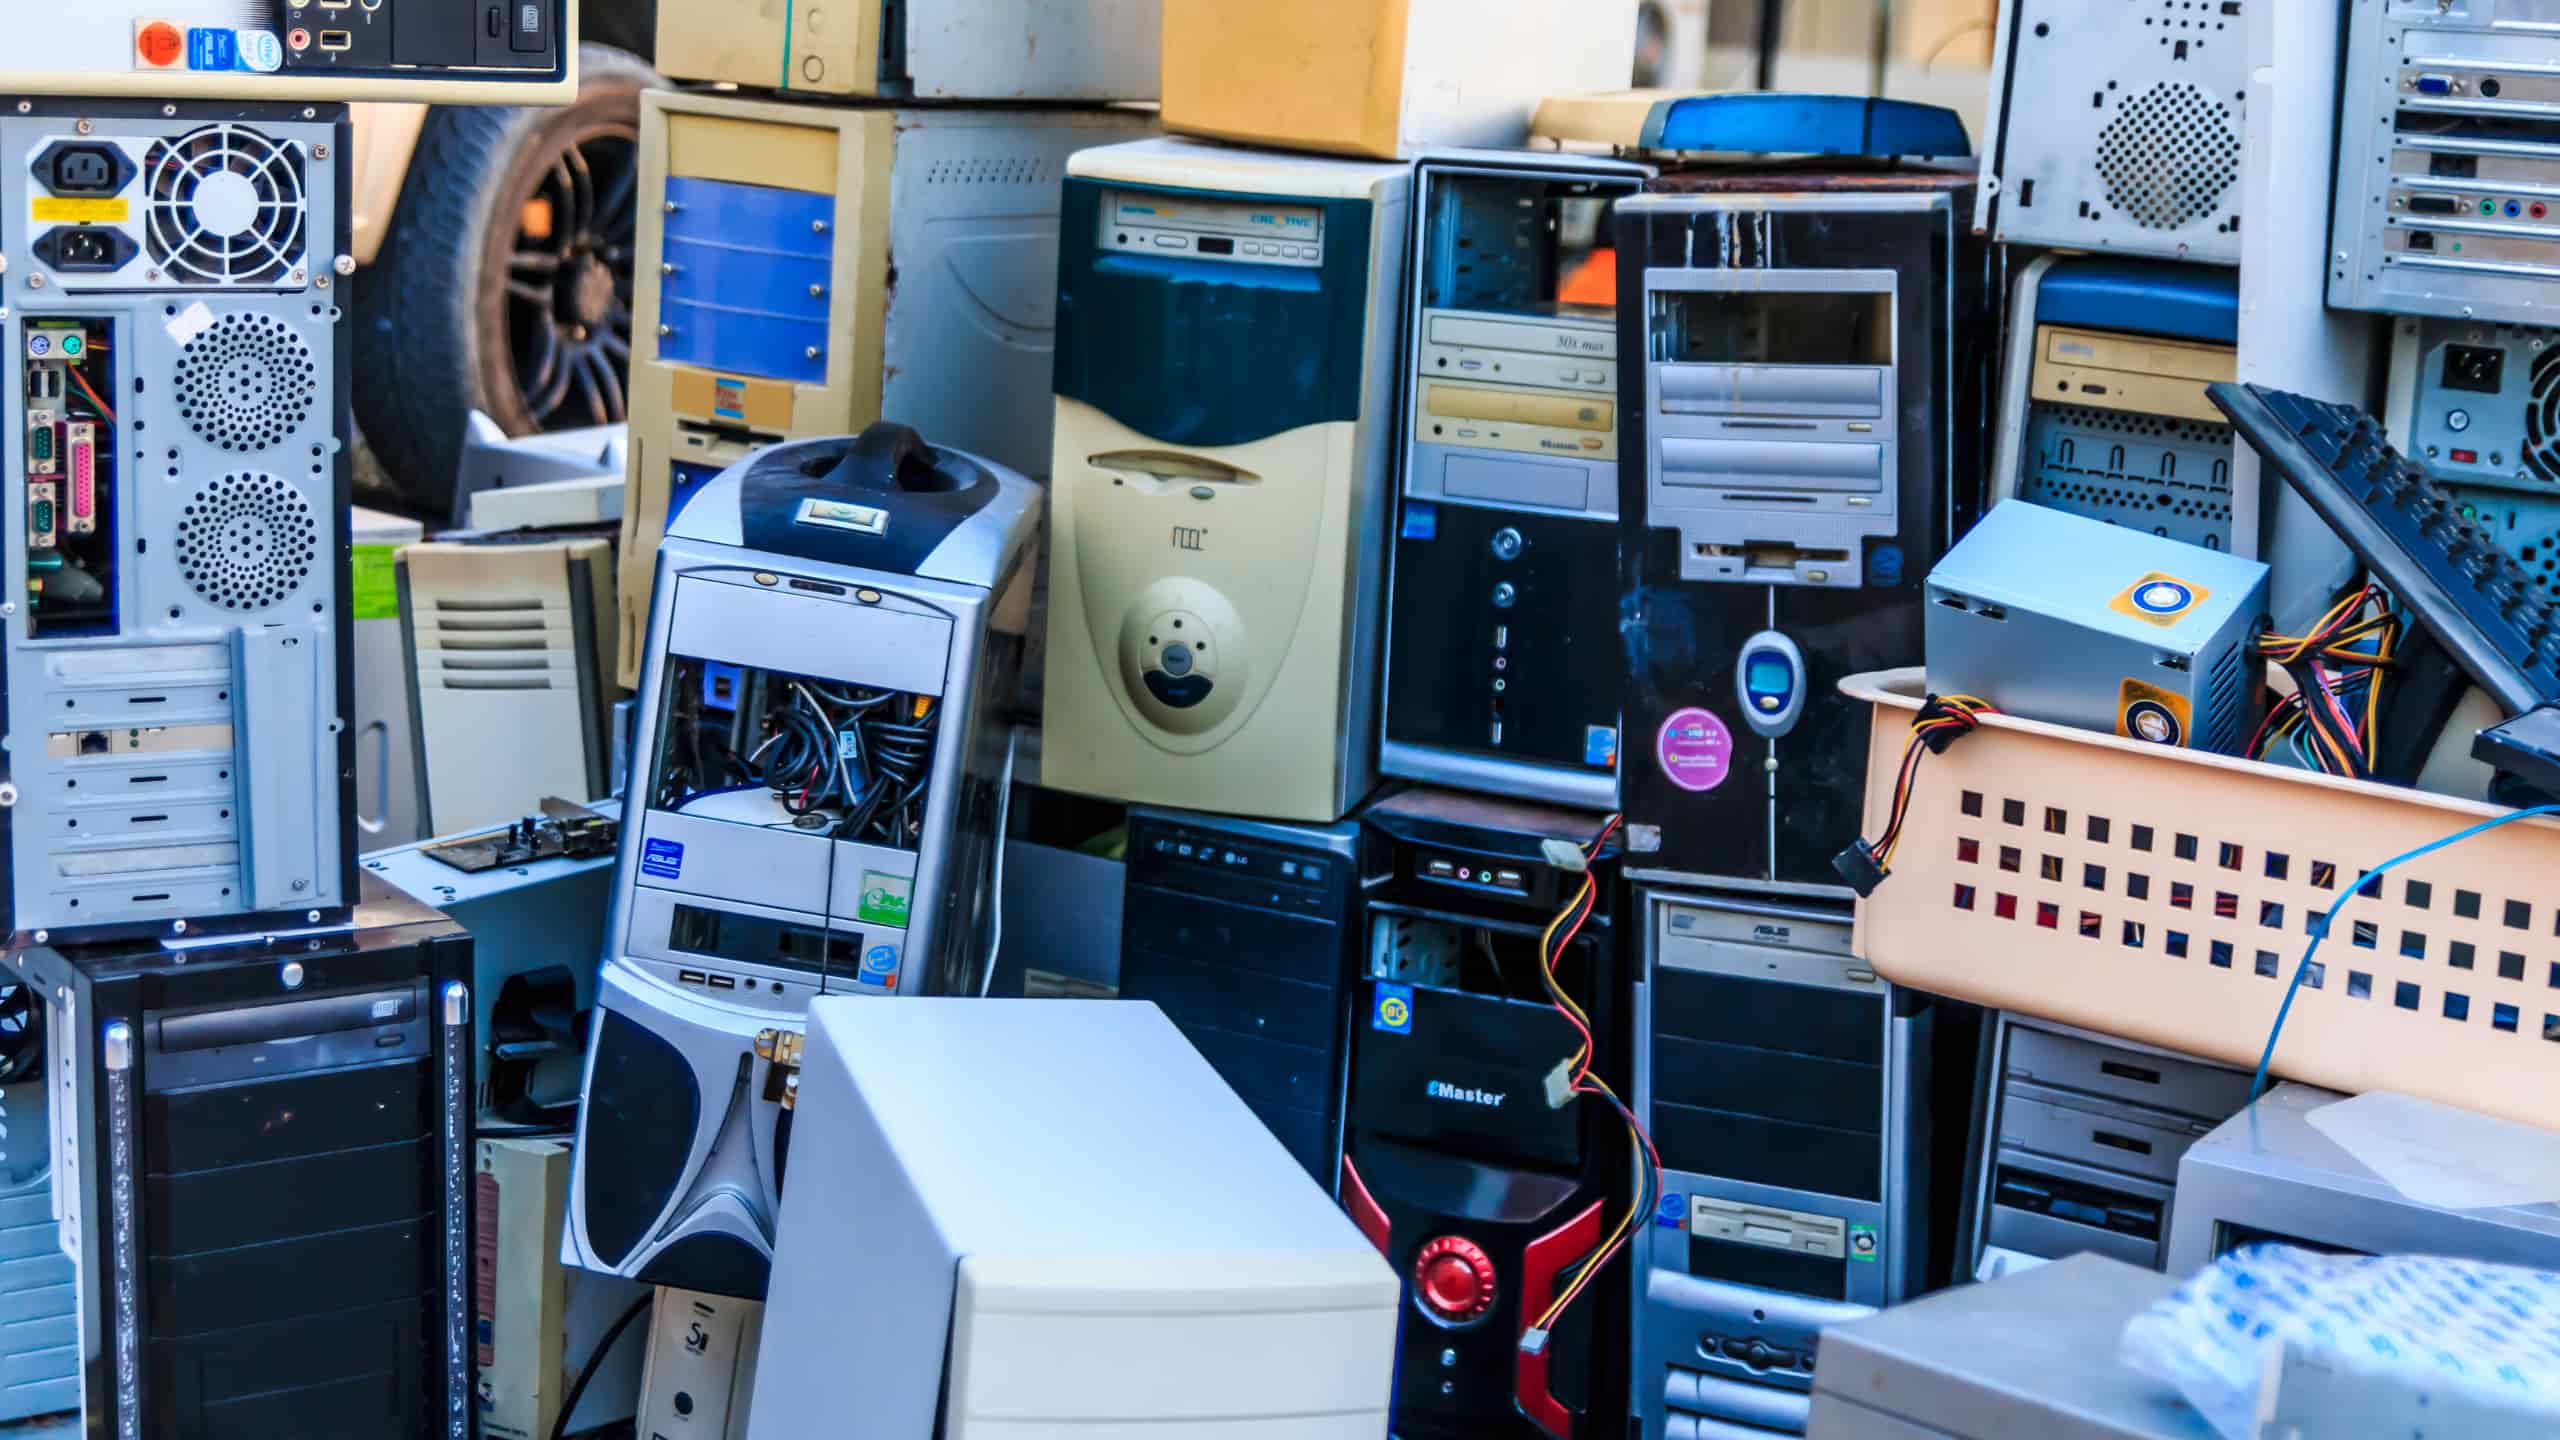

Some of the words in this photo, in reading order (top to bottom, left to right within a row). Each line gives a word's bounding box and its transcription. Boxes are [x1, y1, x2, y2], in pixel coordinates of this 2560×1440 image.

[646, 854, 678, 865] ASUS
[1753, 924, 1790, 937] ASUS
[1427, 1080, 1507, 1107] eMaster
